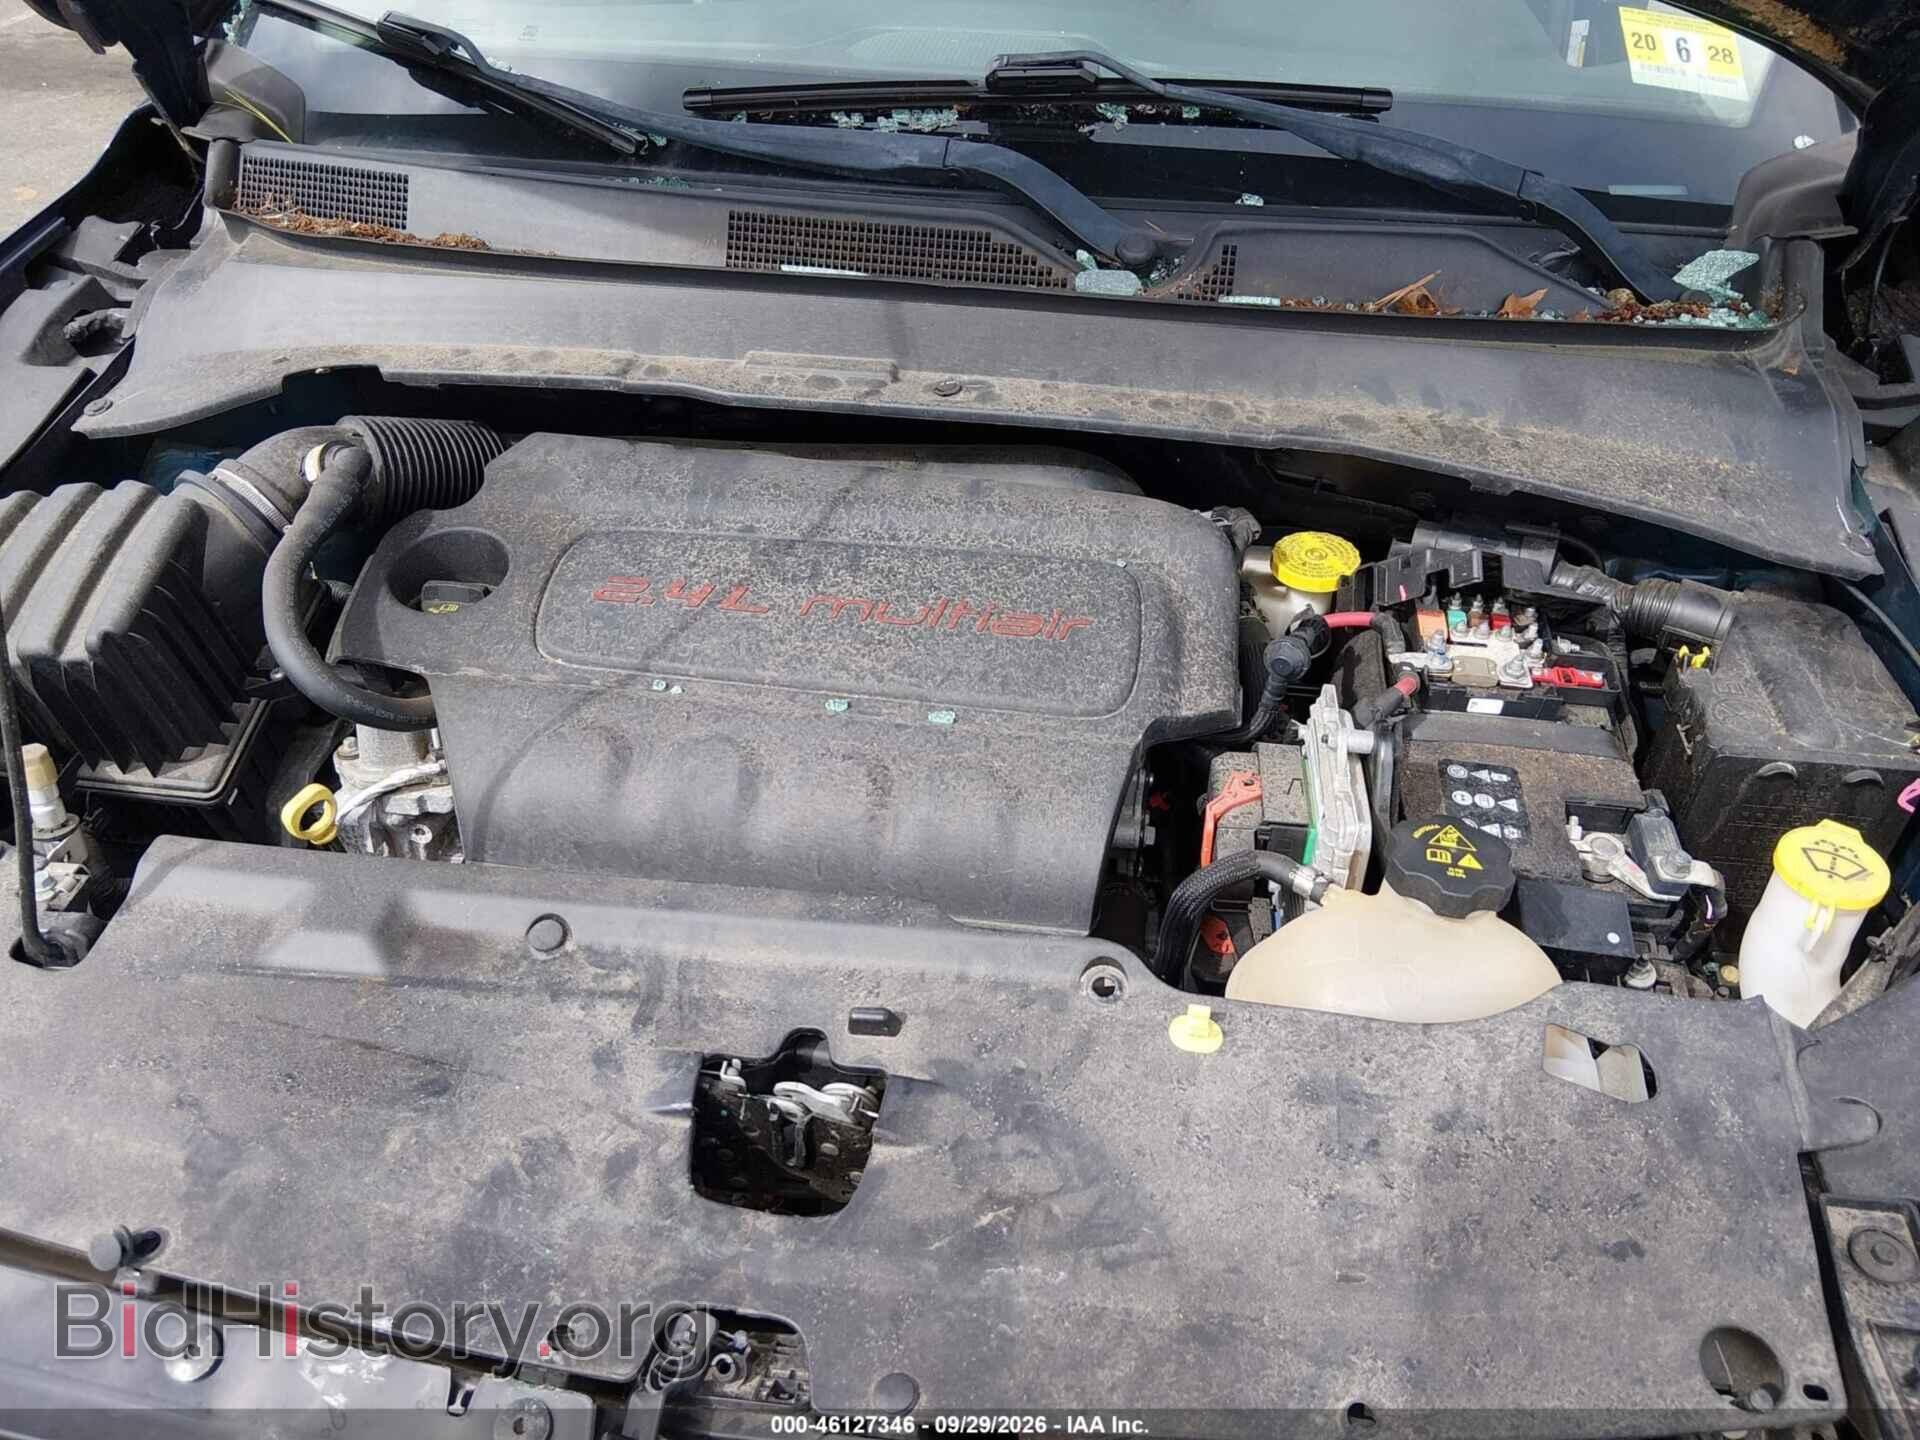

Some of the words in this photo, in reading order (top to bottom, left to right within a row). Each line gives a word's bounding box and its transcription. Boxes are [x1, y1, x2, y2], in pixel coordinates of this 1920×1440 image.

[1631, 32, 1657, 52] 20
[1675, 37, 1691, 63] 6
[1707, 46, 1735, 65] 28
[592, 575, 770, 614] 2.4L
[799, 595, 1094, 641] multiair
